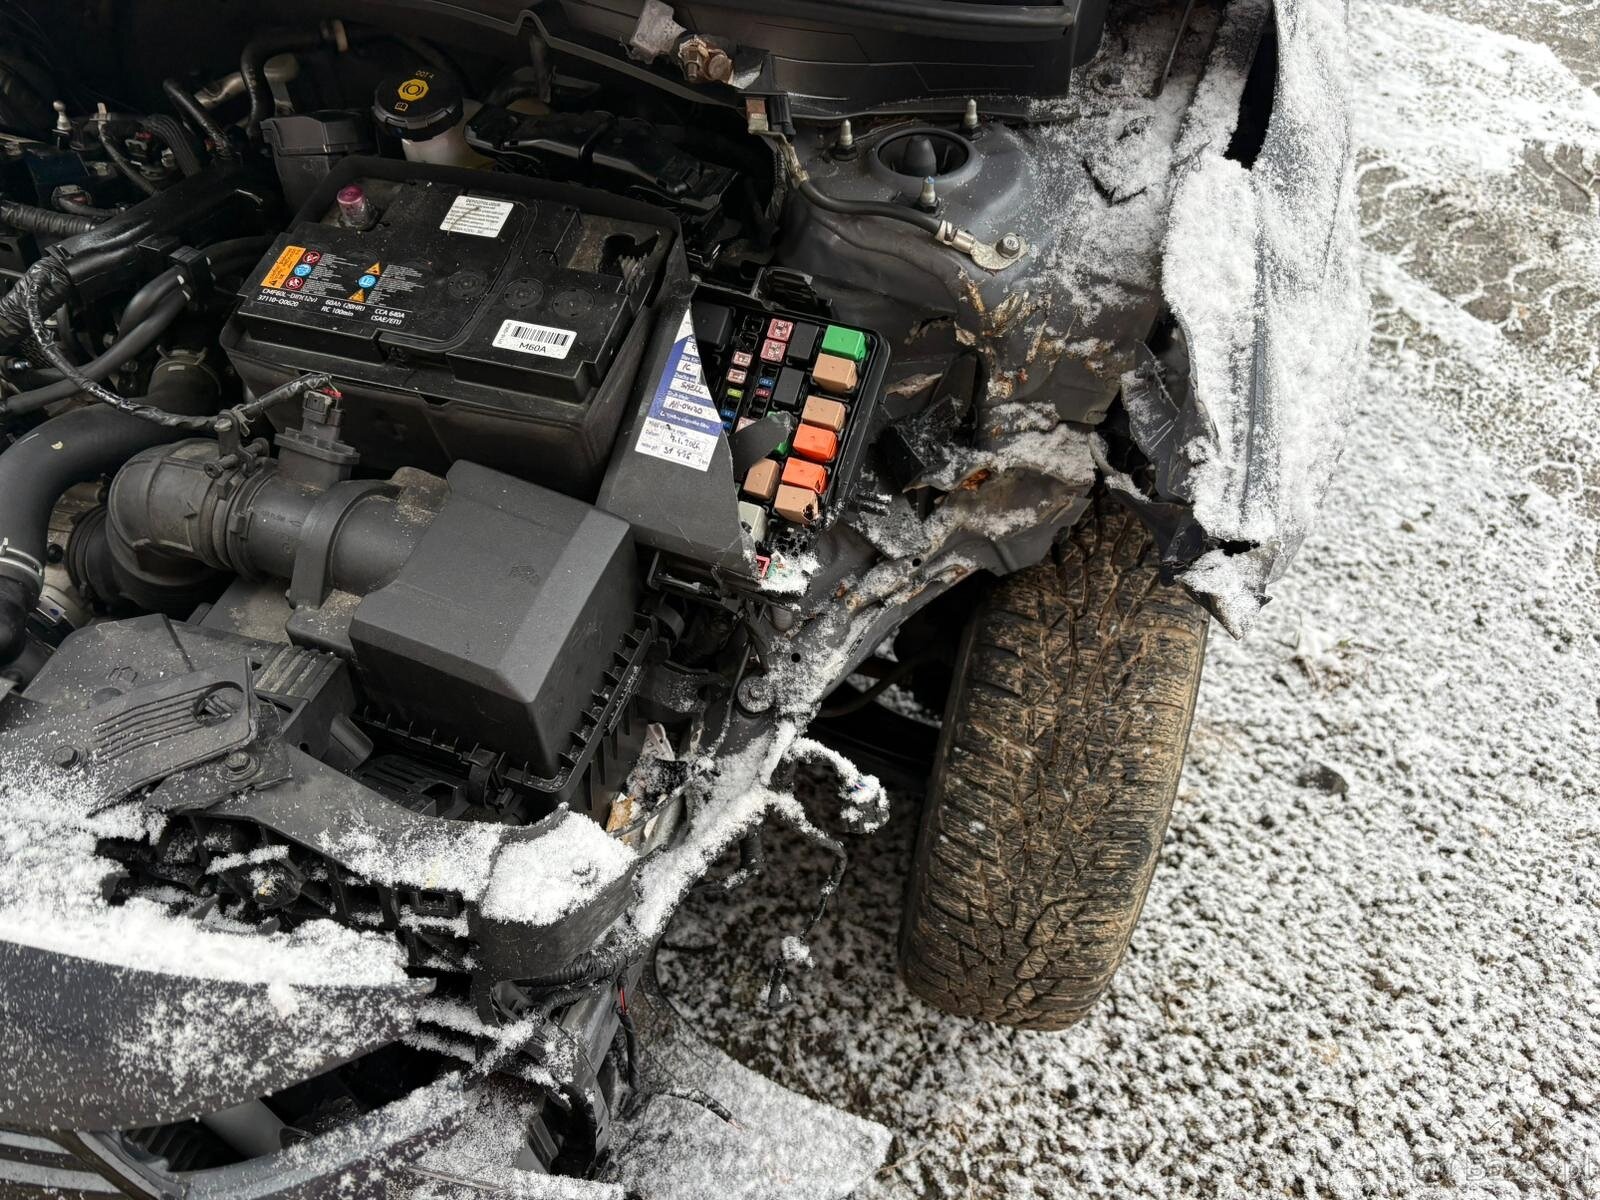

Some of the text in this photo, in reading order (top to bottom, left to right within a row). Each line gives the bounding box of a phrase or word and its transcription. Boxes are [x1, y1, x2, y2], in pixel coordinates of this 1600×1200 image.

[325, 299, 342, 307] 60Ah
[332, 307, 354, 317] 100min
[374, 308, 388, 317] CCA
[518, 342, 547, 353] M60A
